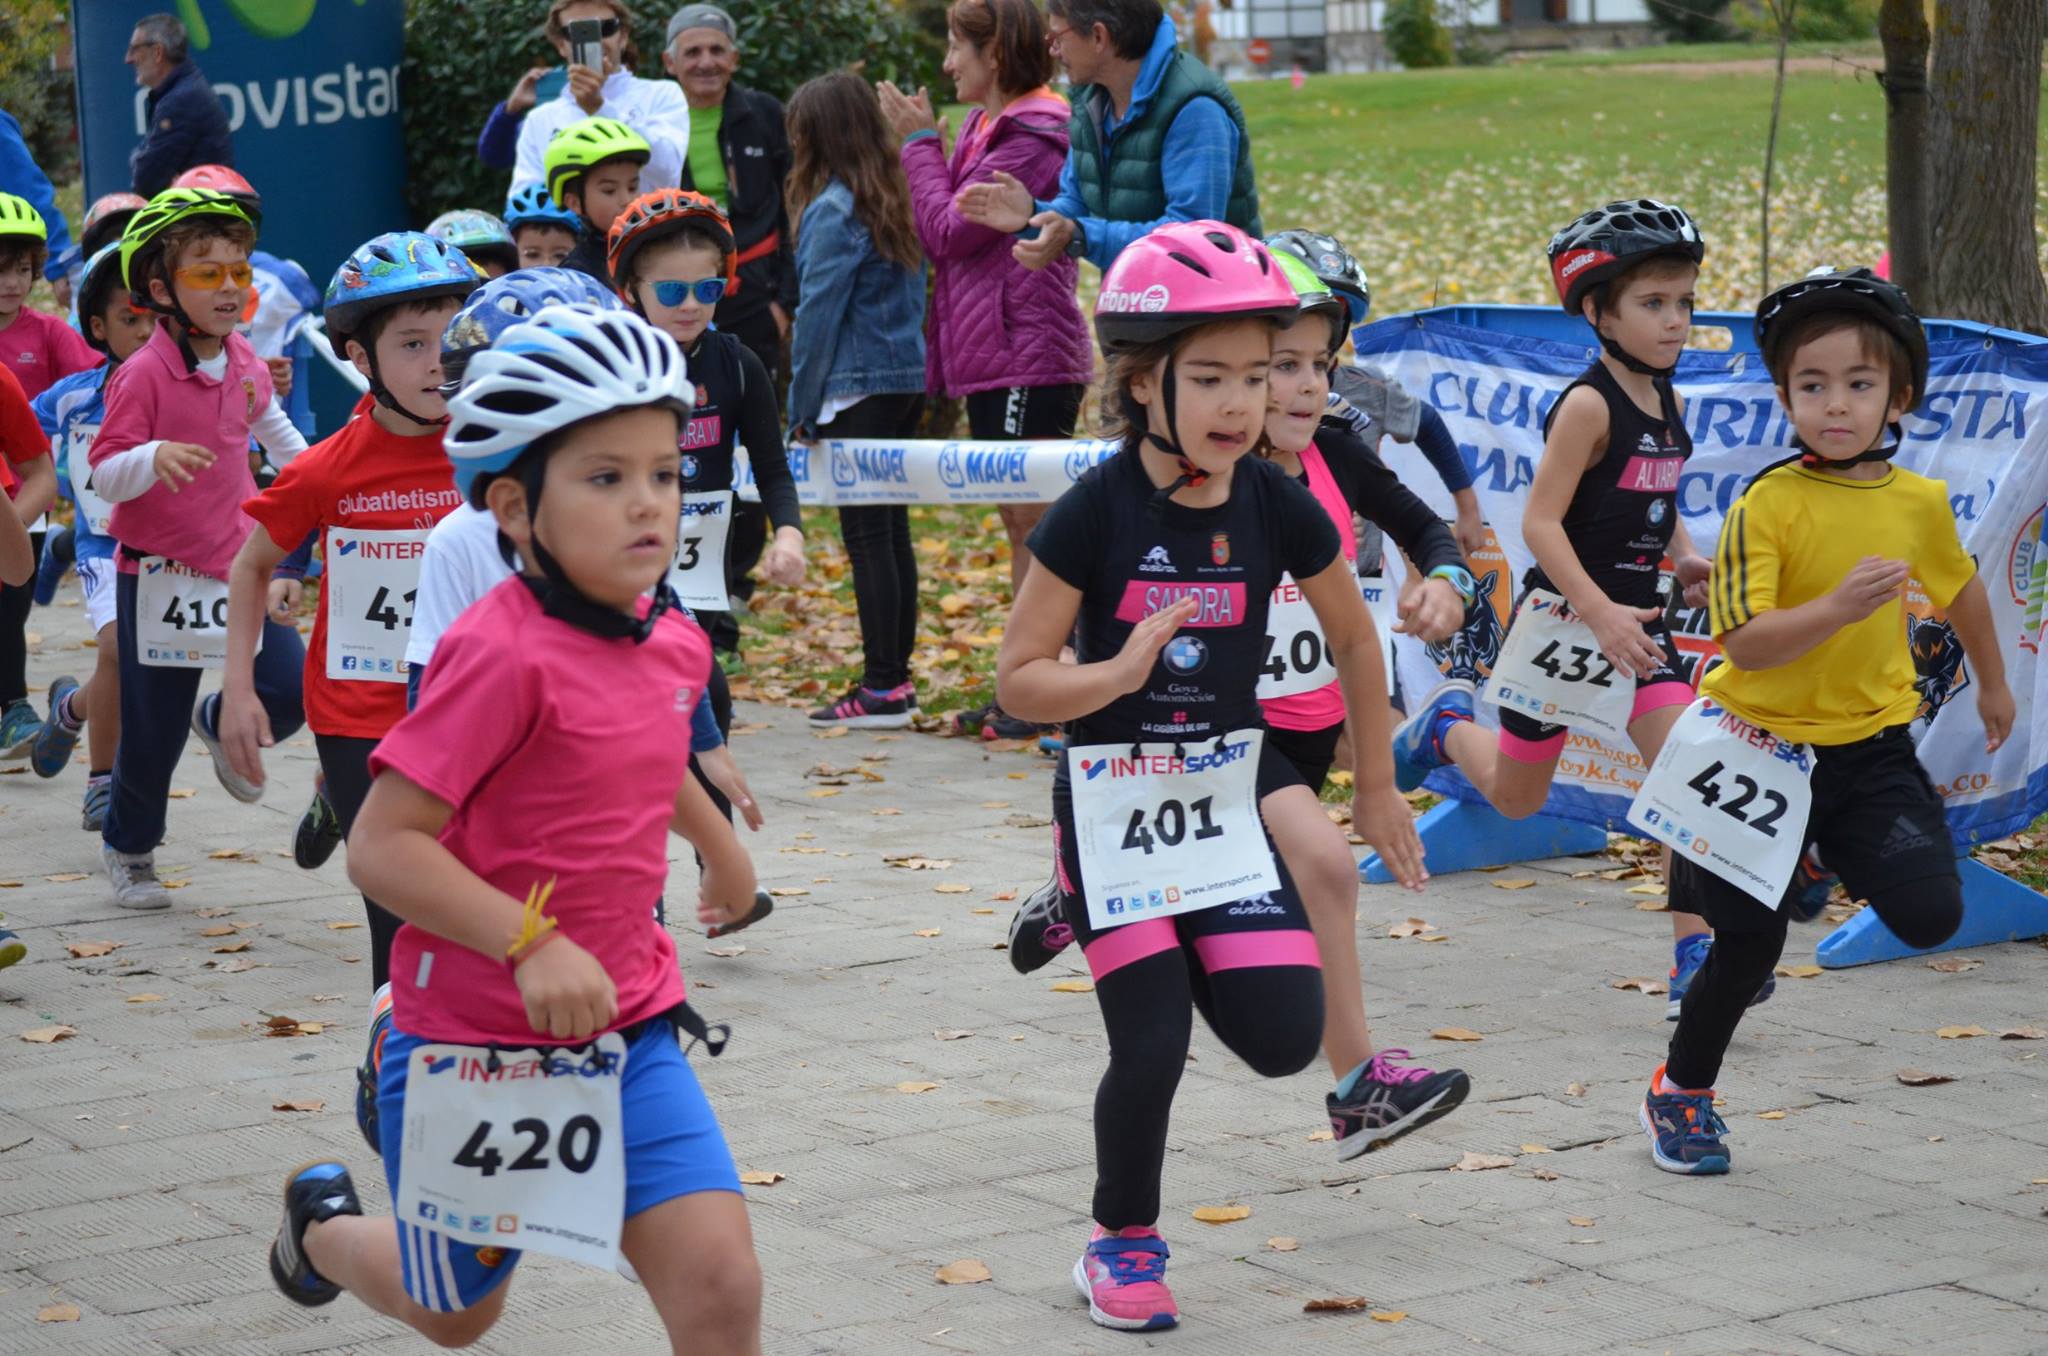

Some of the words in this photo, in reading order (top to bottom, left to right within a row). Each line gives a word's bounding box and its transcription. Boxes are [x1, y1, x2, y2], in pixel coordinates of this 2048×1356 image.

[854, 448, 908, 483] MAPEI
[966, 450, 1028, 483] MAPEI
[2015, 540, 2033, 592] CLUB
[1258, 630, 1336, 682] 40
[1531, 639, 1616, 688] 432
[1110, 740, 1252, 779] INTERSPORT
[1687, 760, 1788, 838] 422
[1120, 795, 1224, 855] 401
[1183, 871, 1264, 897] www.intersport.es
[452, 1114, 602, 1177] 420
